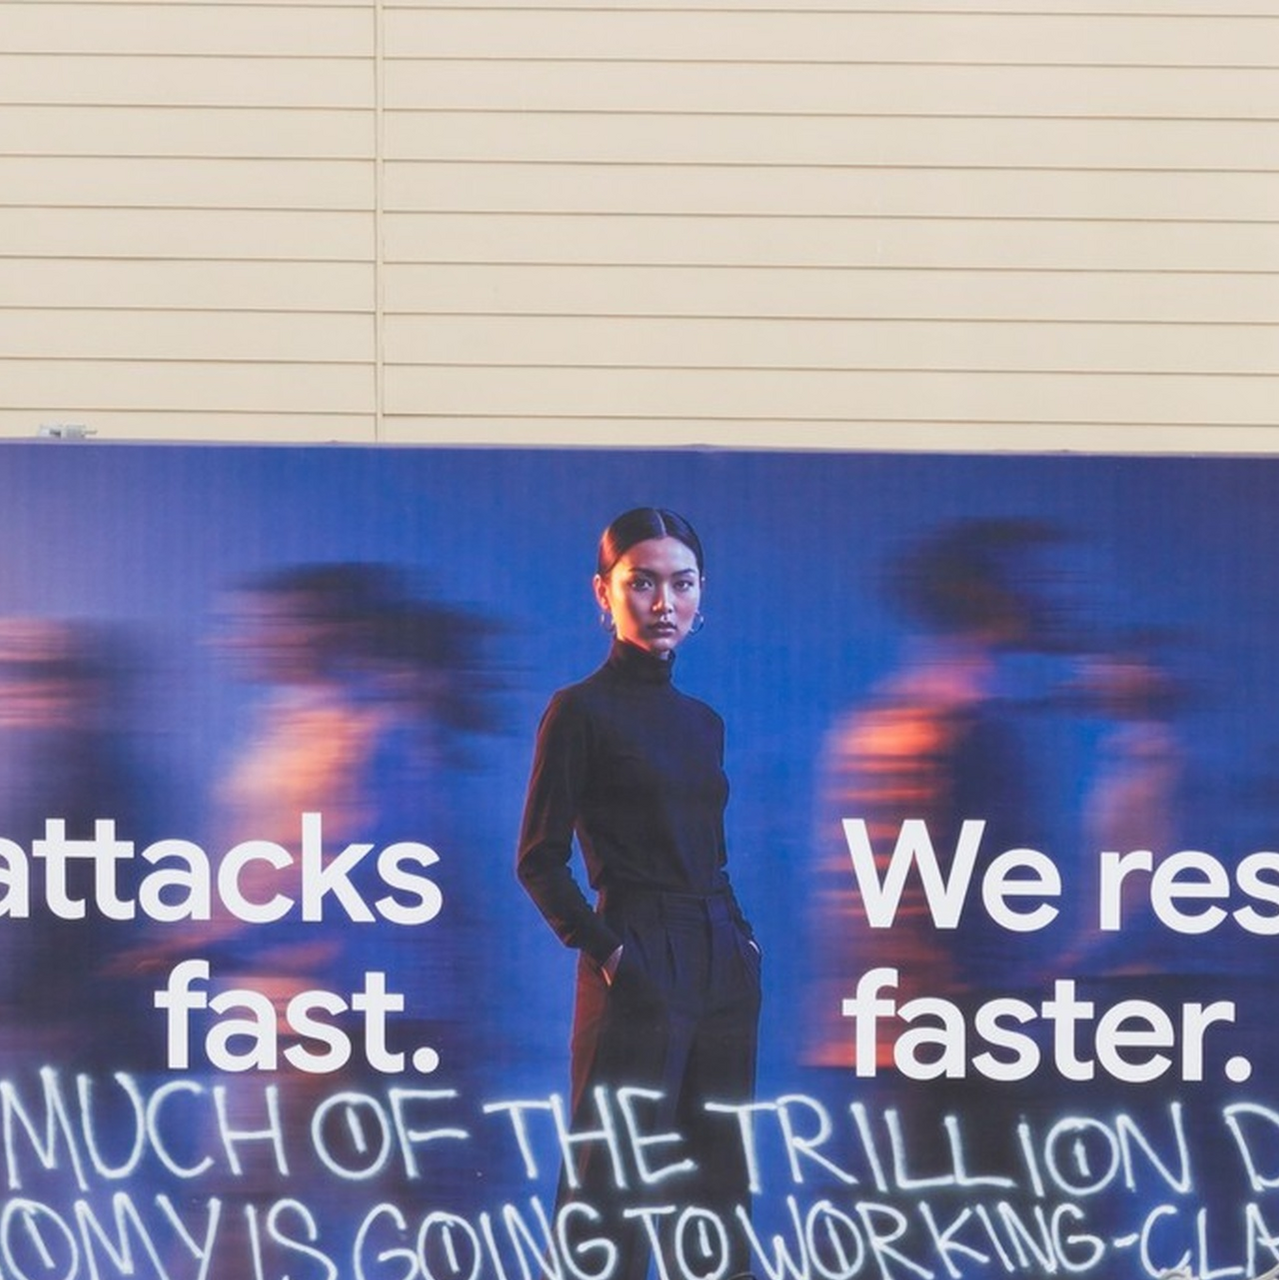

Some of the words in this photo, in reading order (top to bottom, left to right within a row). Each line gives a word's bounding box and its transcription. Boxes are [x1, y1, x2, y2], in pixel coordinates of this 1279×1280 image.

[841, 818, 1062, 933] We
[154, 959, 441, 1073] fast.
[841, 967, 1252, 1083] faster.
[0, 1066, 289, 1190] MUCH
[312, 1089, 468, 1181] OF
[482, 1084, 695, 1190] THE
[707, 1094, 1194, 1197] TRILLION
